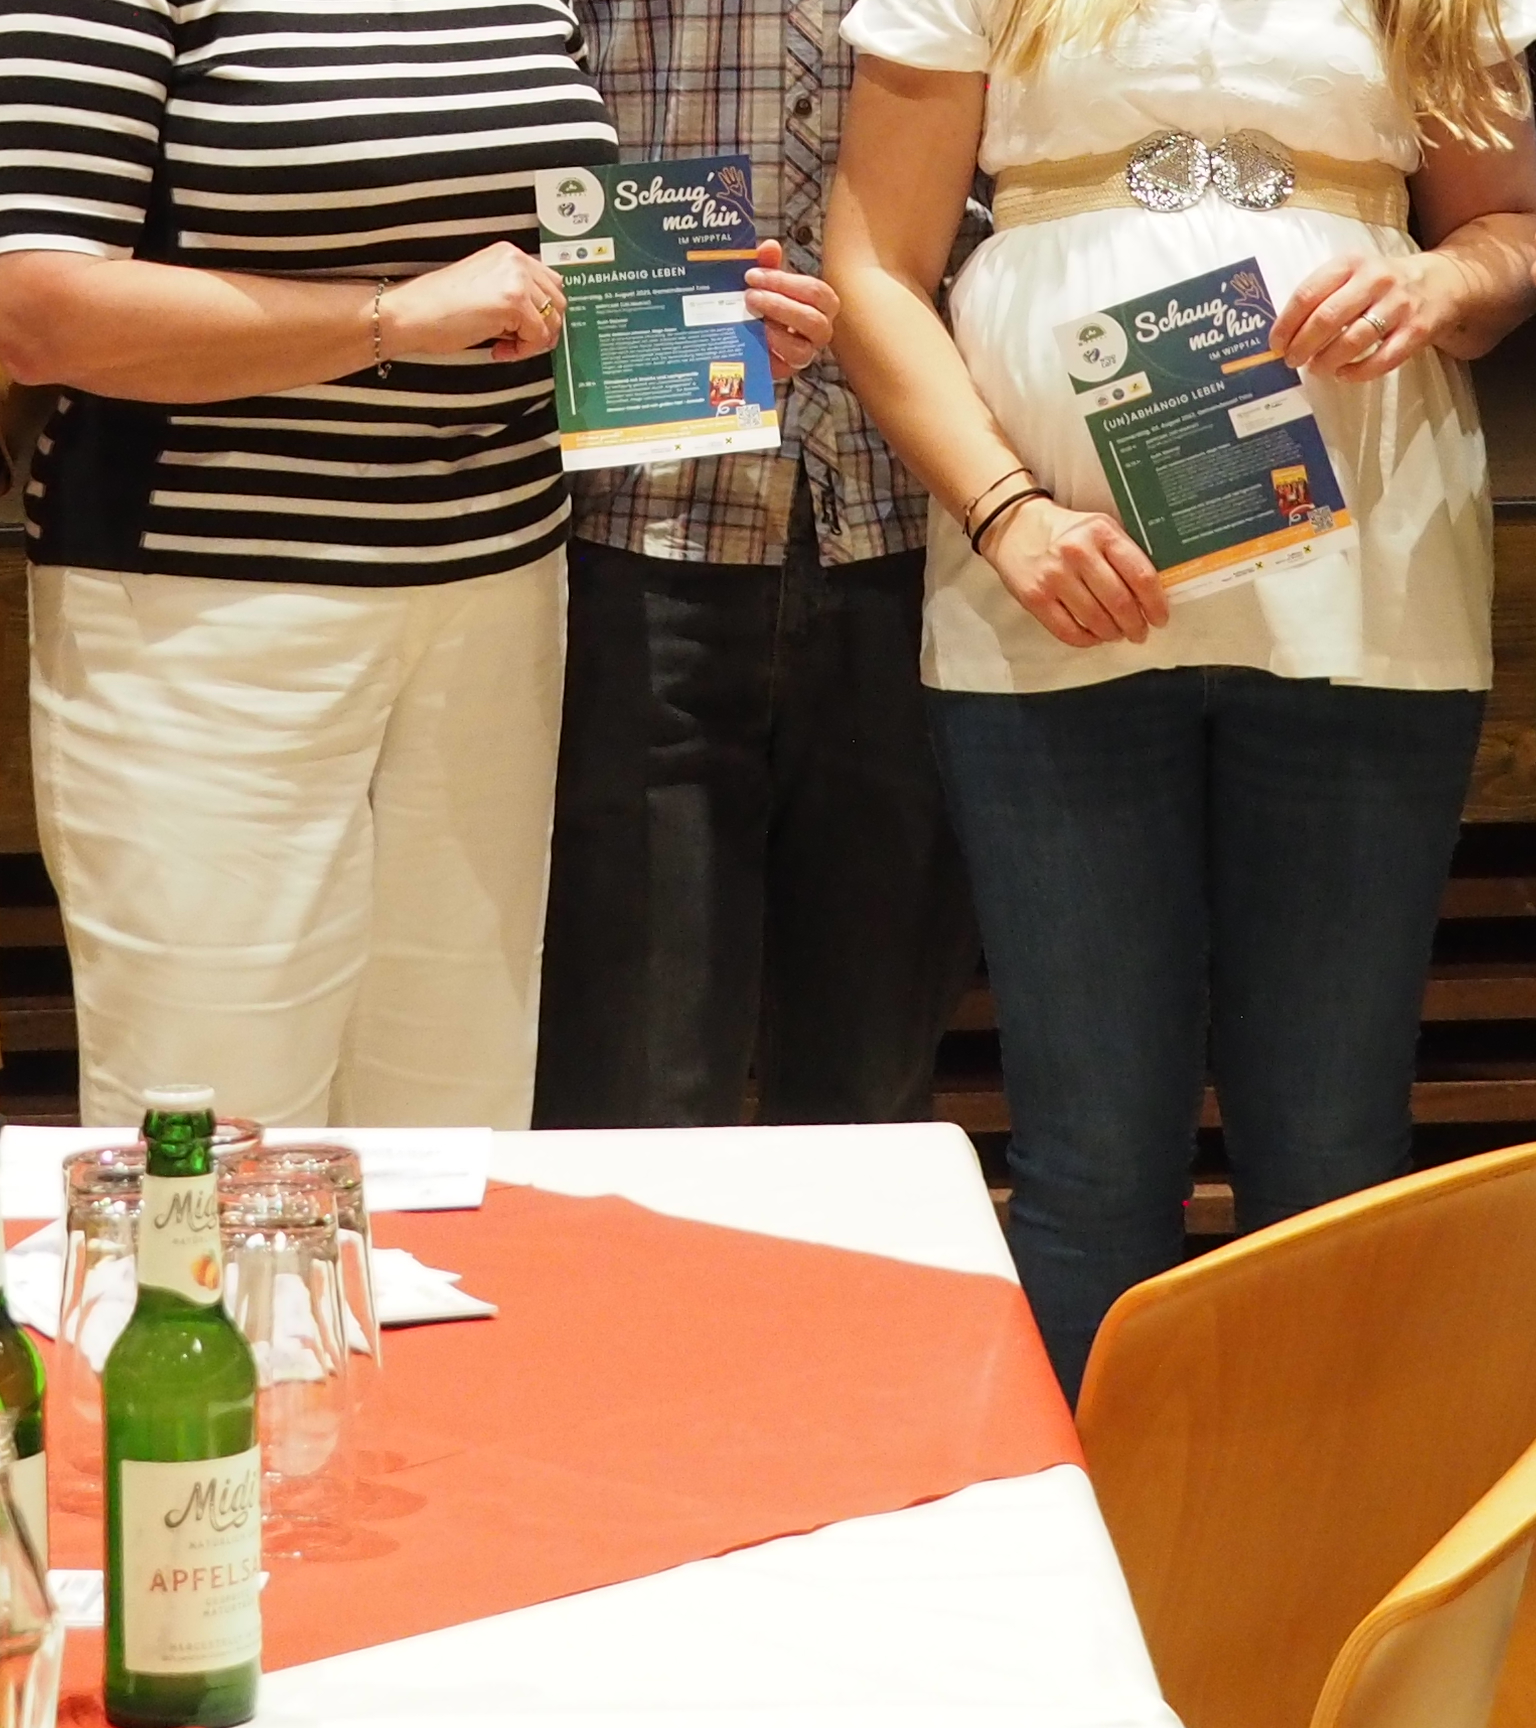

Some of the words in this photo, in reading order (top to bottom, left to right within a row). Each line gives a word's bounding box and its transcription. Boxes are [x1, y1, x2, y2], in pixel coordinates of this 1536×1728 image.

[663, 214, 698, 231] ma
[702, 199, 742, 228] hin
[692, 233, 732, 244] WIPPTAL
[652, 266, 686, 279] LEBEN
[1189, 329, 1224, 351] ma
[1226, 308, 1266, 338] hin
[1221, 337, 1262, 357] WIPPTAL
[1191, 380, 1226, 401] LEBEN
